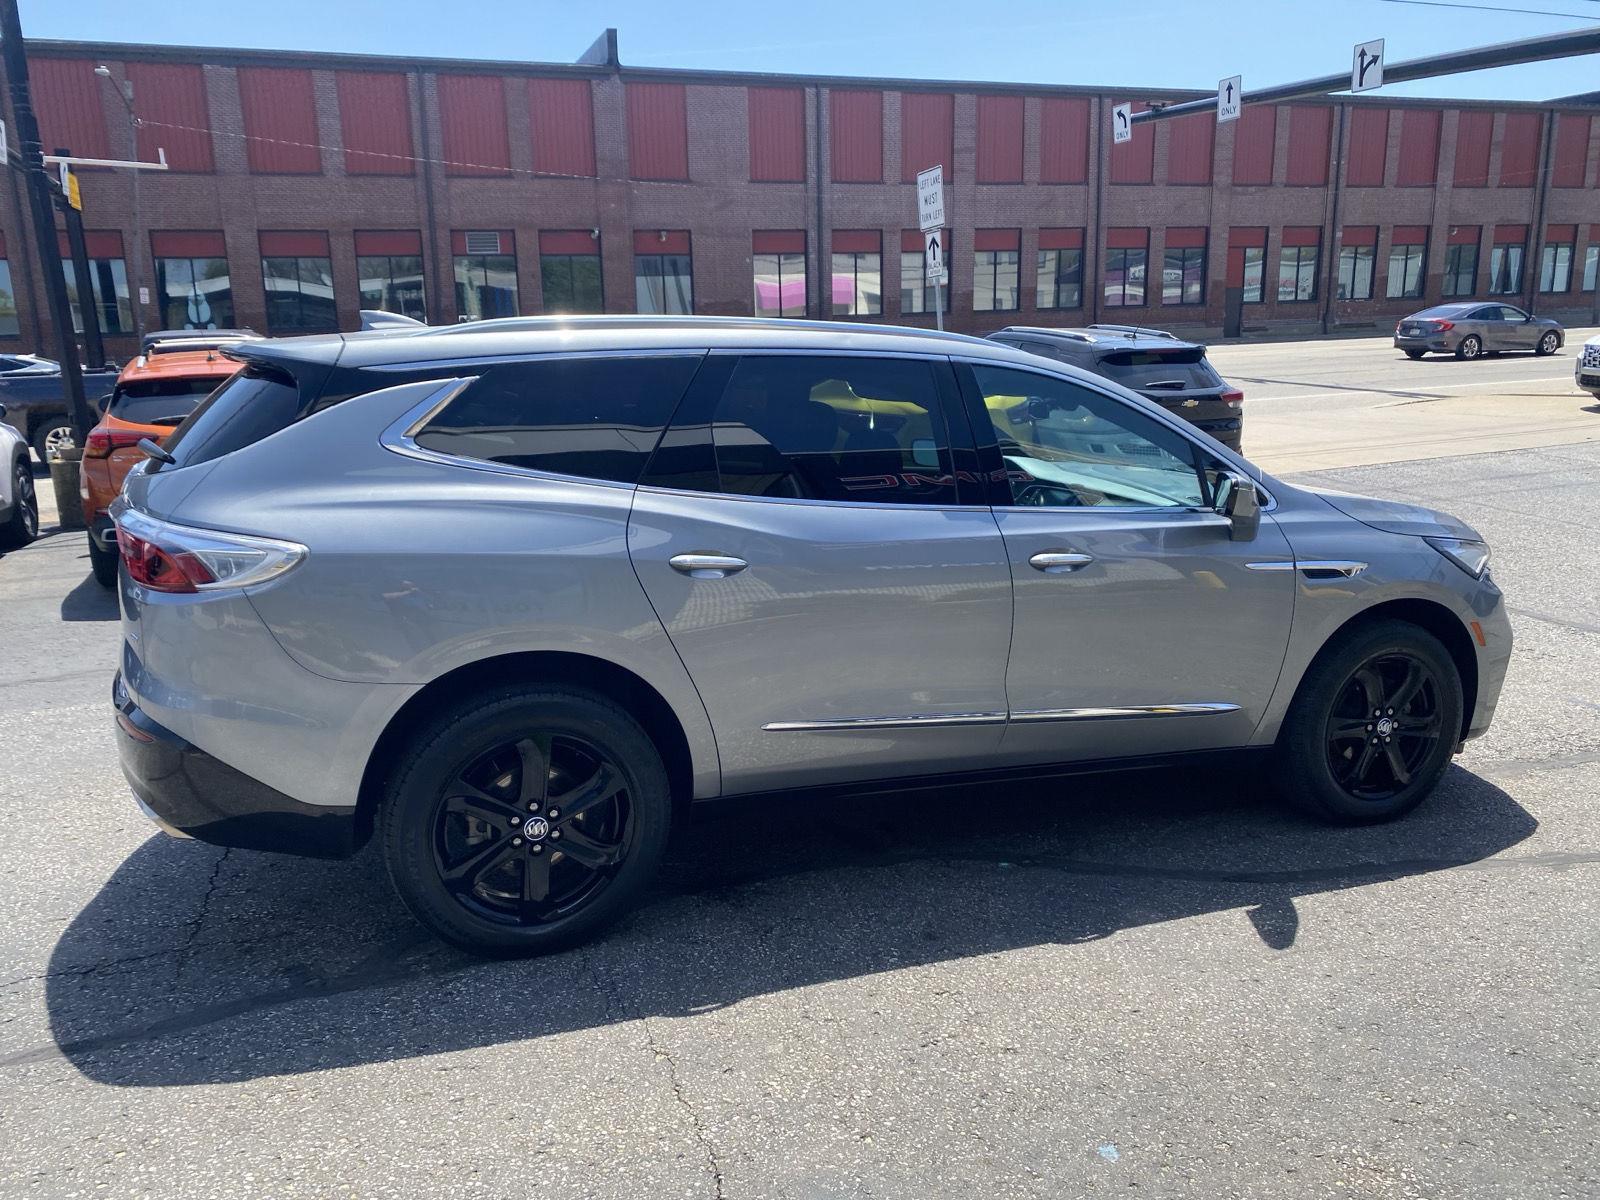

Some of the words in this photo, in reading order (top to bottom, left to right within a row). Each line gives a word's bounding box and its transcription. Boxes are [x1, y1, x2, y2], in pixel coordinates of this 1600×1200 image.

[1221, 105, 1237, 116] ONLY
[1116, 129, 1129, 140] ONLY
[920, 179, 929, 190] LEFT
[931, 175, 940, 186] LANE
[924, 192, 938, 205] MUST
[921, 212, 932, 222] TURN
[933, 209, 943, 220] LEFT
